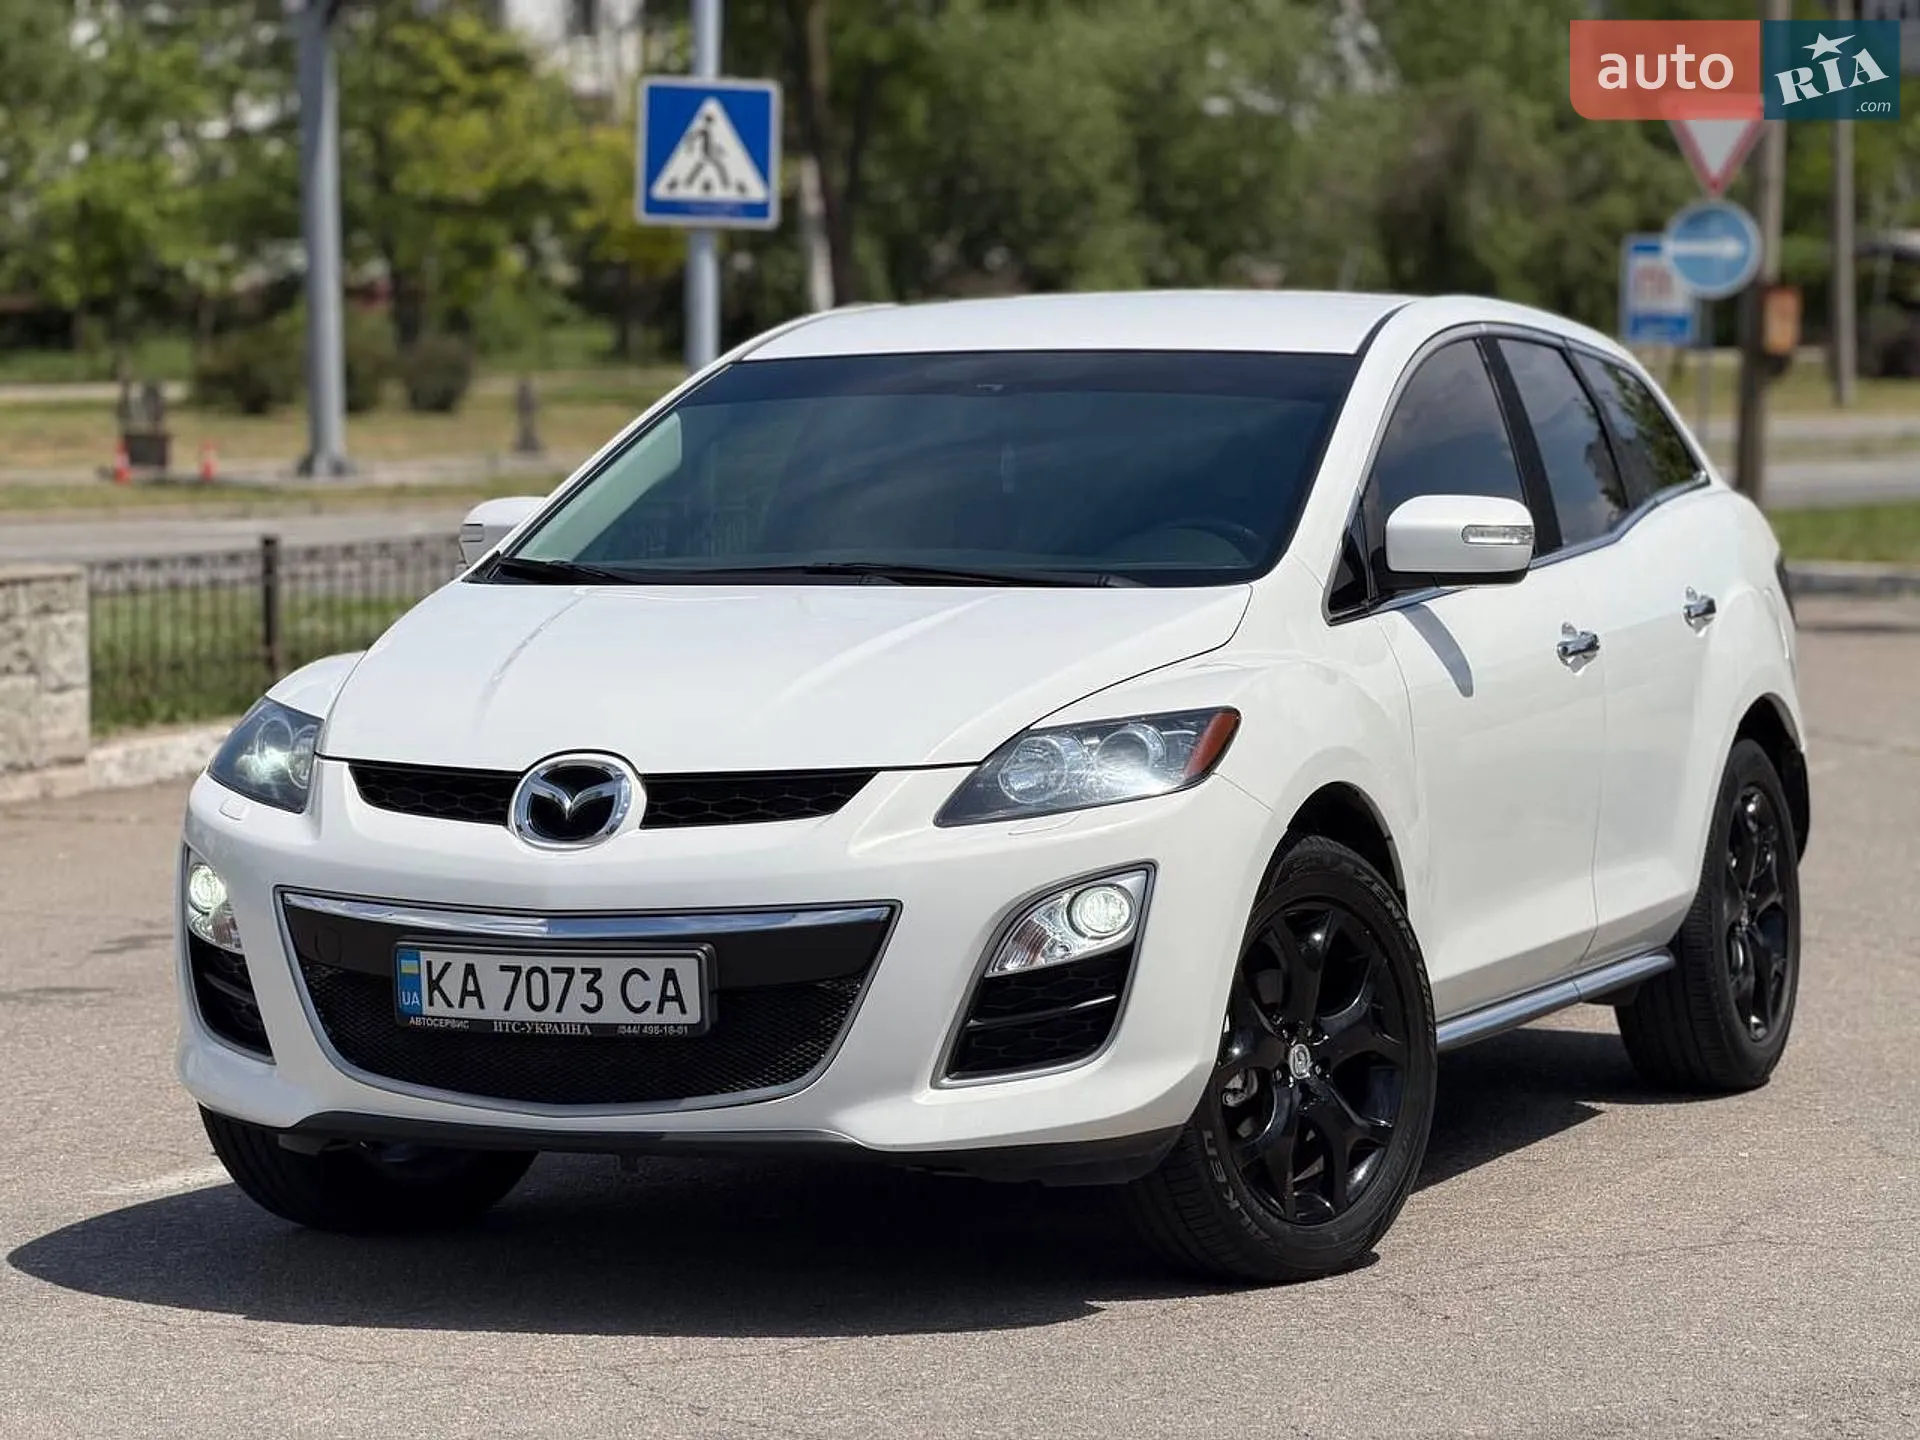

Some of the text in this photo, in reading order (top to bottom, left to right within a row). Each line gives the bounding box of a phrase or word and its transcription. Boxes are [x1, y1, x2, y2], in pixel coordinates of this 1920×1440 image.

[426, 960, 688, 1015] KA 7073 CA
[401, 992, 421, 1007] UA
[409, 1016, 470, 1030] АВТОСЕРВИС
